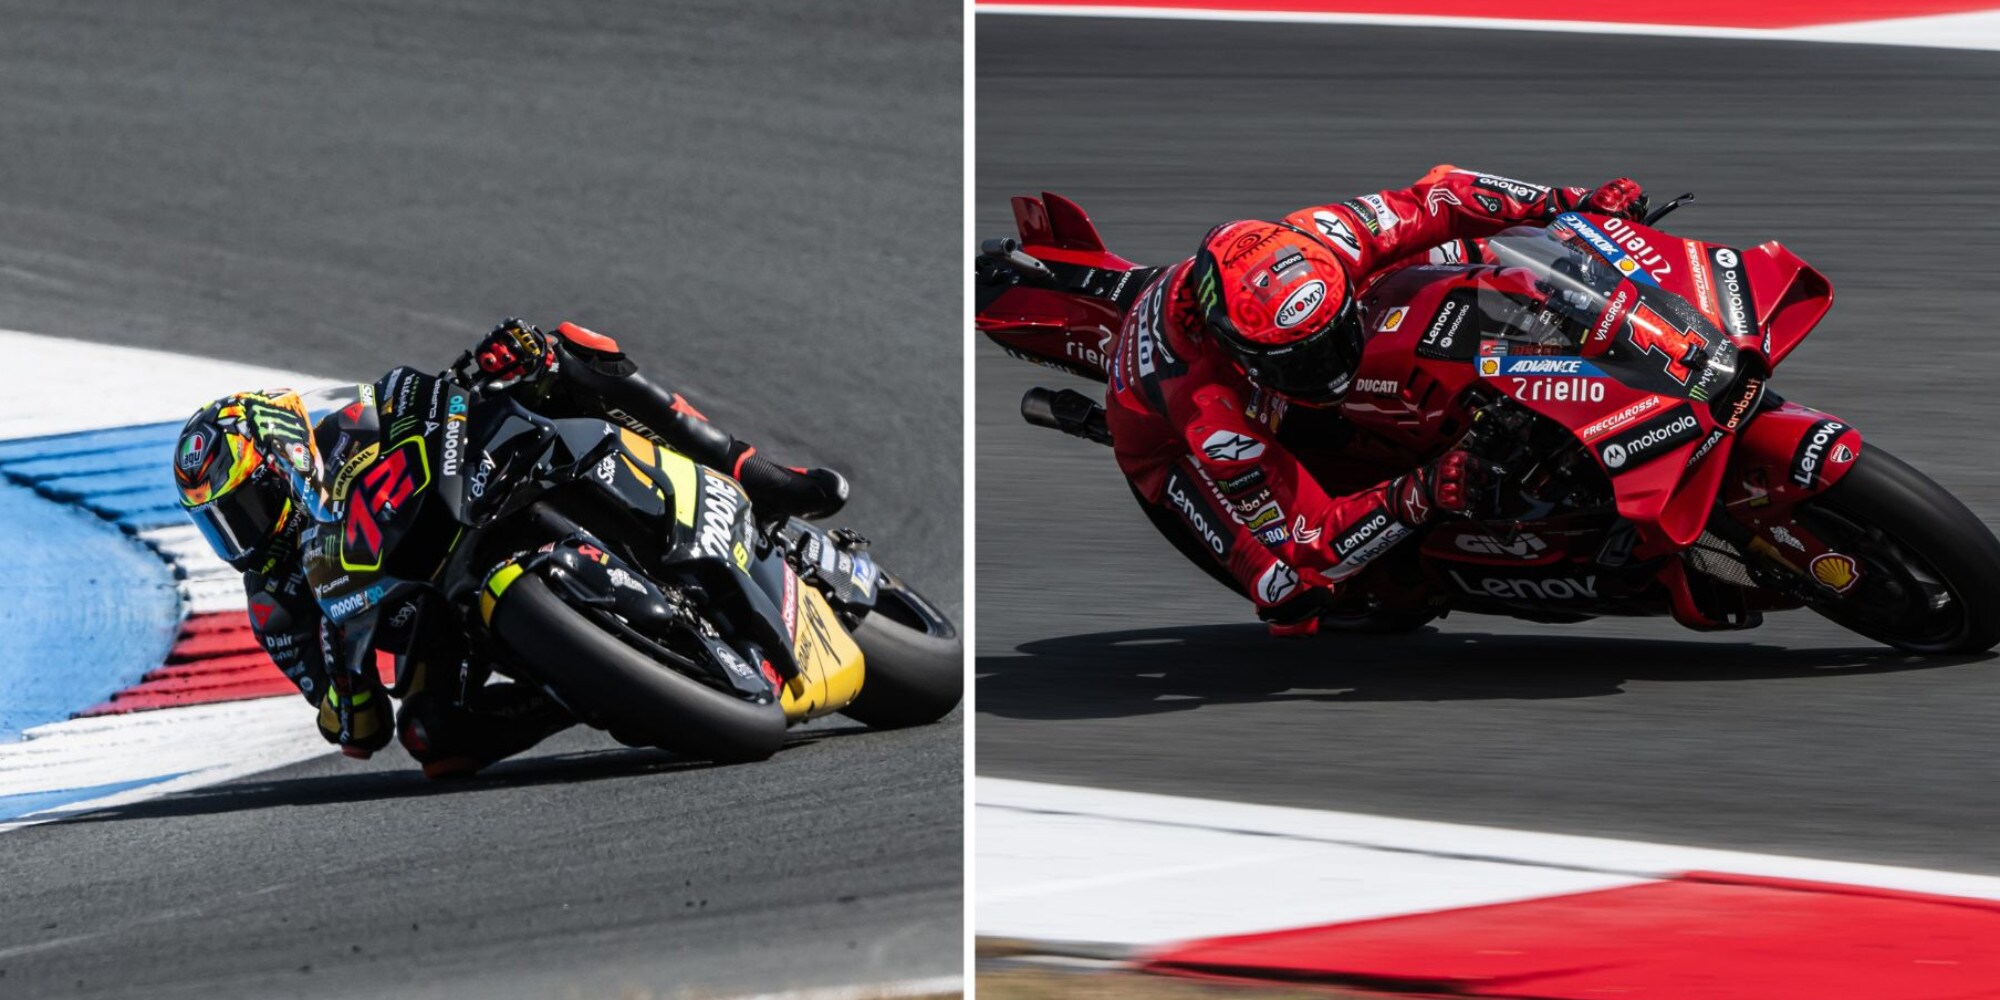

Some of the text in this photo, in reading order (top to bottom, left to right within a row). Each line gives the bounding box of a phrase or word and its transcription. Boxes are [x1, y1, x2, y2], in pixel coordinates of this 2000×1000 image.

[1479, 178, 1537, 201] Lenovo
[1562, 215, 1619, 255] ADVANCE
[1603, 218, 1662, 265] riello
[1272, 255, 1302, 272] Lenovo
[1687, 242, 1710, 313] FRECCIAROSSA
[1111, 271, 1131, 302] DUCATI
[1279, 287, 1323, 322] SUOMY
[1725, 270, 1748, 335] motorola
[1423, 301, 1455, 345] Lenovo
[1448, 304, 1470, 337] motorola
[1066, 341, 1111, 376] riell
[1627, 301, 1709, 386] 1
[1356, 379, 1398, 393] DUCATI
[1508, 360, 1582, 373] ADVANCE
[429, 379, 442, 419] CUPRA
[1583, 396, 1660, 438] FRECCIAROSSA
[1727, 377, 1762, 428] aruba.it
[443, 395, 467, 476] mooneygo
[606, 408, 676, 450] DAINE
[1627, 415, 1697, 455] motorola
[336, 450, 375, 497] BARDAHL
[470, 450, 496, 497] ebay
[1794, 422, 1843, 485] Lenovo
[346, 448, 415, 556] 72
[700, 472, 742, 560] moone
[1167, 475, 1223, 554] Lenovo
[1336, 515, 1387, 555] Lenovo
[322, 575, 349, 593] CUPRA
[330, 586, 384, 617] mooneygo
[1449, 570, 1598, 598] Lenov
